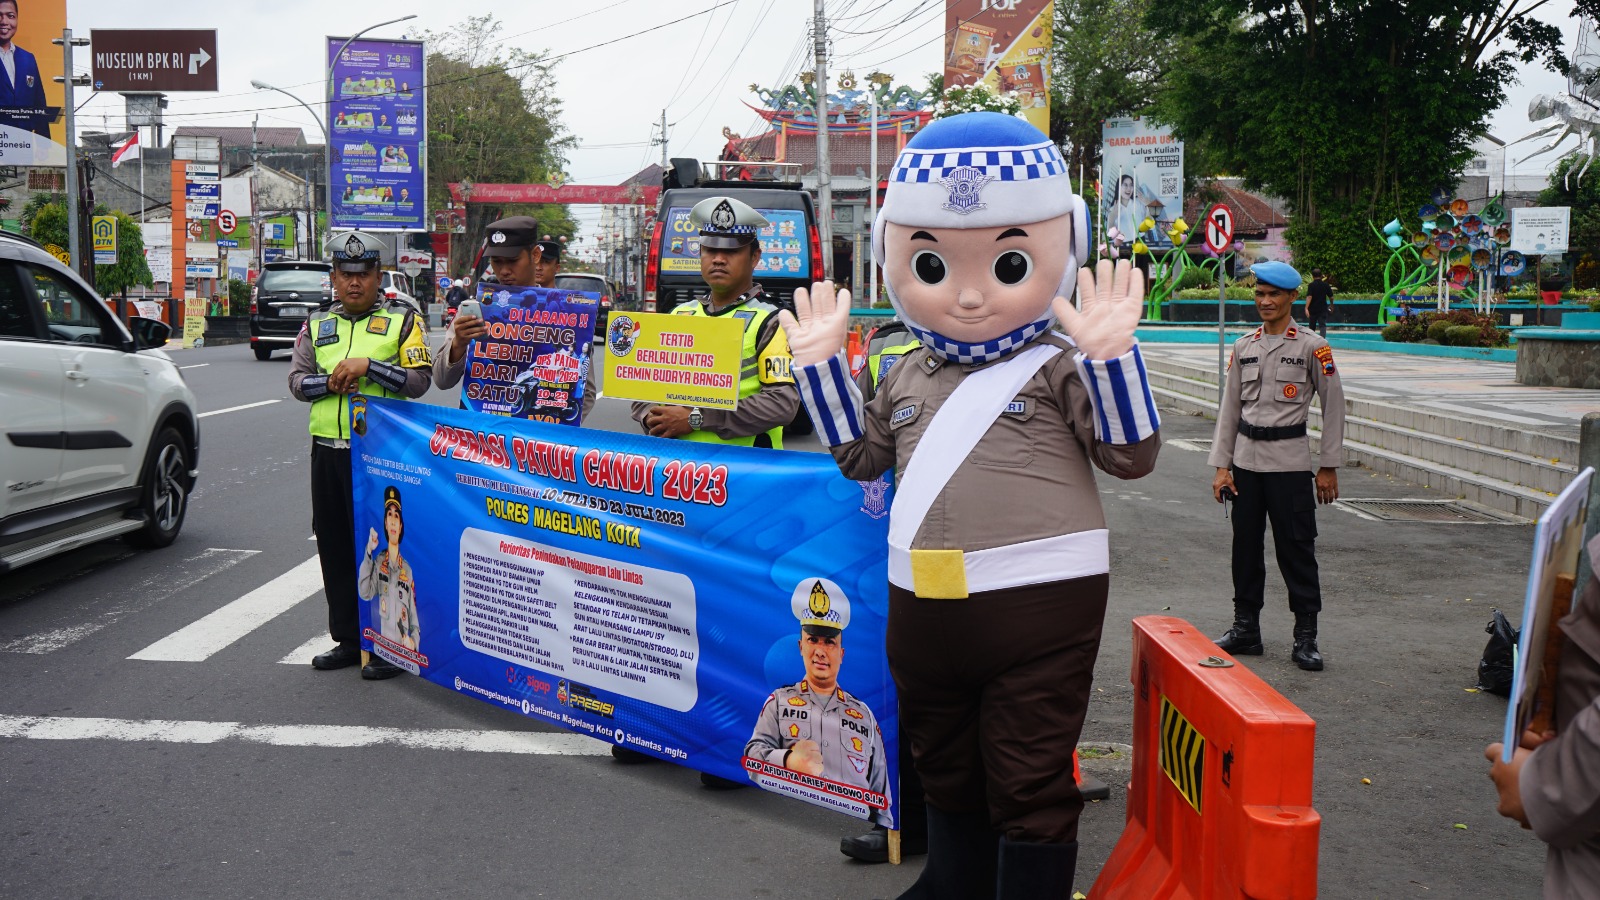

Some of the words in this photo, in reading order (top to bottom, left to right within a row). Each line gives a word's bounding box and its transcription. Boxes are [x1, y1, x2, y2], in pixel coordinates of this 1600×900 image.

[96, 52, 144, 69] MUSEUM
[147, 52, 169, 69] BPK
[172, 52, 184, 68] RI
[1012, 72, 1031, 80] TOP
[1130, 147, 1152, 155] Lulus
[1154, 145, 1180, 154] Kuliah
[94, 238, 113, 246] BTN
[509, 308, 523, 322] DI
[525, 308, 577, 327] LARANG
[659, 332, 694, 348] TERTIB
[473, 341, 533, 363] LEBIH
[536, 354, 551, 366] OPS
[554, 353, 579, 369] PATUH
[636, 349, 677, 365] BERLALU
[679, 351, 714, 368] LINTAS
[1280, 357, 1305, 366] POLRI
[470, 362, 518, 382] DARI
[533, 368, 557, 383] CANDI
[559, 370, 579, 383] 2023
[616, 365, 651, 381] CERMIN
[652, 368, 692, 385] BUDAYA
[693, 371, 733, 389] BANGSA
[467, 382, 520, 404] SATU
[537, 389, 550, 399] 10
[554, 390, 568, 400] 23
[702, 396, 723, 405] MAGELANG
[430, 423, 511, 469] OPERASI
[512, 437, 578, 483] PATUH
[583, 449, 658, 496] CANDI
[663, 459, 728, 507] 2023
[456, 473, 490, 489] TERHITUNG
[511, 484, 541, 499] TANGGAL
[541, 487, 557, 501] 10
[557, 490, 588, 508] JULI
[609, 500, 623, 515] 23
[624, 503, 655, 522] JULI
[655, 507, 685, 527] 2023
[486, 496, 529, 525] POLRES
[533, 506, 602, 541] MAGELANG
[606, 520, 641, 548] KOTA
[466, 561, 491, 574] PENGEMUDI
[500, 540, 531, 560] Perioritas
[531, 547, 567, 567] Penindakan
[567, 556, 606, 577] Pelanggaran
[607, 565, 621, 581] Lalu
[622, 568, 644, 586] Lintas
[500, 560, 536, 575] MENGGUNAKAN
[537, 569, 544, 577] HP
[466, 570, 494, 584] PENGENDARA
[524, 586, 538, 595] HELM
[466, 580, 491, 592] PENGEMUDI
[527, 596, 544, 606] SAFETI
[544, 601, 557, 609] BELT
[466, 589, 491, 601] PENGEMUDI
[502, 599, 527, 612] PENGARUH
[528, 607, 552, 619] ALKOHOL
[574, 591, 615, 606] KELENGKAPAN
[615, 601, 648, 615] KENDARAAN
[649, 608, 668, 620] SESUAI
[627, 592, 671, 609] MENGGUNAKAN
[465, 599, 497, 614] PELANGGARAN
[510, 612, 527, 622] RAMBU
[465, 608, 487, 620] MELAWAN
[501, 618, 518, 629] PARKIR
[518, 623, 529, 632] LIAR
[573, 601, 602, 614] SETANDAR
[602, 608, 610, 617] YG
[611, 610, 630, 621] TELAH
[638, 616, 668, 630] TETAPKAN
[465, 617, 497, 632] PELANGGARAN
[508, 629, 522, 640] TIDAK
[522, 634, 540, 645] SESUAI
[573, 623, 588, 633] ARAT
[588, 626, 602, 637] LALU
[602, 629, 621, 641] LINTAS
[574, 612, 586, 621] GUN
[632, 627, 654, 638] LAMPU
[655, 631, 665, 641] ISY
[465, 626, 496, 641] PERSYARATAN
[496, 635, 512, 647] TEKNIS
[513, 640, 523, 650] DAN
[523, 644, 535, 653] LAIK
[535, 647, 551, 658] JALAN
[465, 635, 497, 651] PELANGGARAN
[498, 646, 529, 662] BERBALAPAN
[535, 657, 551, 668] JALAN
[551, 662, 565, 672] RAYA
[572, 635, 584, 645] RAN
[585, 638, 597, 648] GAR
[597, 641, 616, 652] BERAT
[643, 653, 660, 664] TIDAK
[661, 657, 682, 670] SESUAI
[572, 646, 609, 663] PERUNTUKAN
[615, 657, 629, 668] LAIK
[629, 661, 648, 673] JALAN
[649, 667, 668, 677] SERTA
[669, 671, 681, 681] PER
[585, 660, 600, 671] LALU
[600, 664, 620, 677] LINTAS
[620, 669, 646, 684] LAINNYA
[569, 693, 615, 716] PRESISI
[782, 707, 808, 720] AFID
[530, 703, 561, 721] Satlantas
[562, 713, 595, 733] Magelang
[596, 724, 613, 738] Kota
[841, 718, 869, 738] POLRI
[746, 759, 762, 770] AKP
[763, 765, 800, 782] AFIDITYA
[801, 775, 826, 789] ARIEF
[826, 782, 863, 800] WIBOWO
[761, 779, 778, 788] KASAT
[778, 783, 799, 795] LANTAS
[799, 789, 820, 801] POLRES
[820, 795, 850, 810] MAGELANG
[851, 805, 867, 815] KOTA
